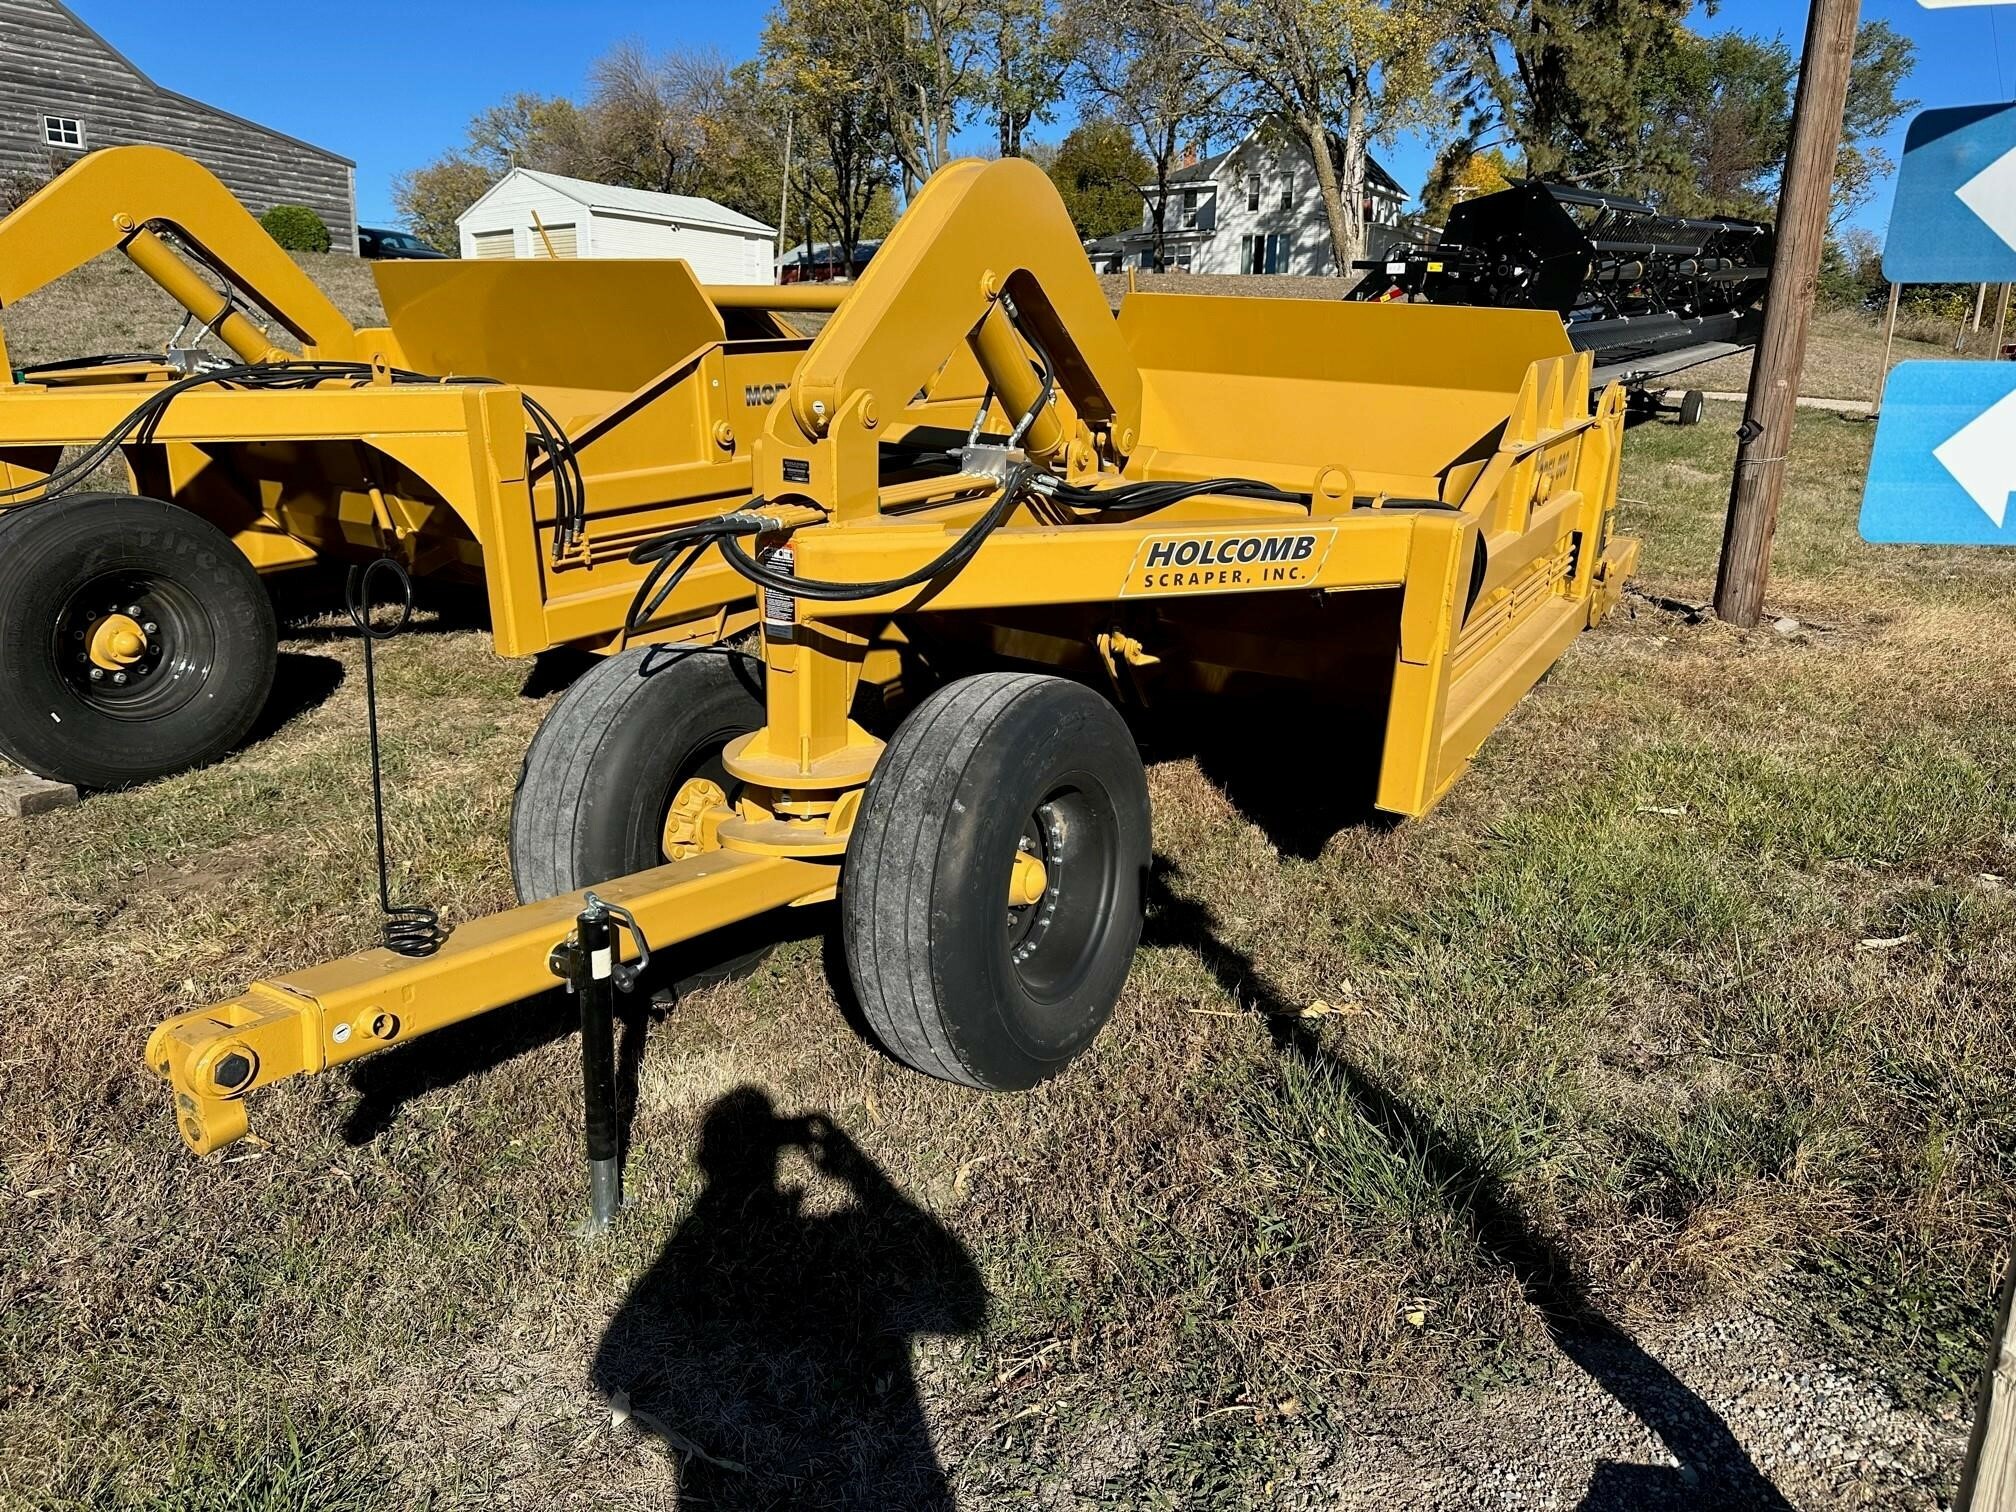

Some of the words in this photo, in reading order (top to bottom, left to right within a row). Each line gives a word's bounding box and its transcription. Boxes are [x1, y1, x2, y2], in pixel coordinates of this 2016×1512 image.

[745, 383, 792, 407] MO
[1145, 535, 1317, 568] HOLCOMB
[1144, 569, 1251, 588] SCRAPER,
[1263, 566, 1306, 582] INC.
